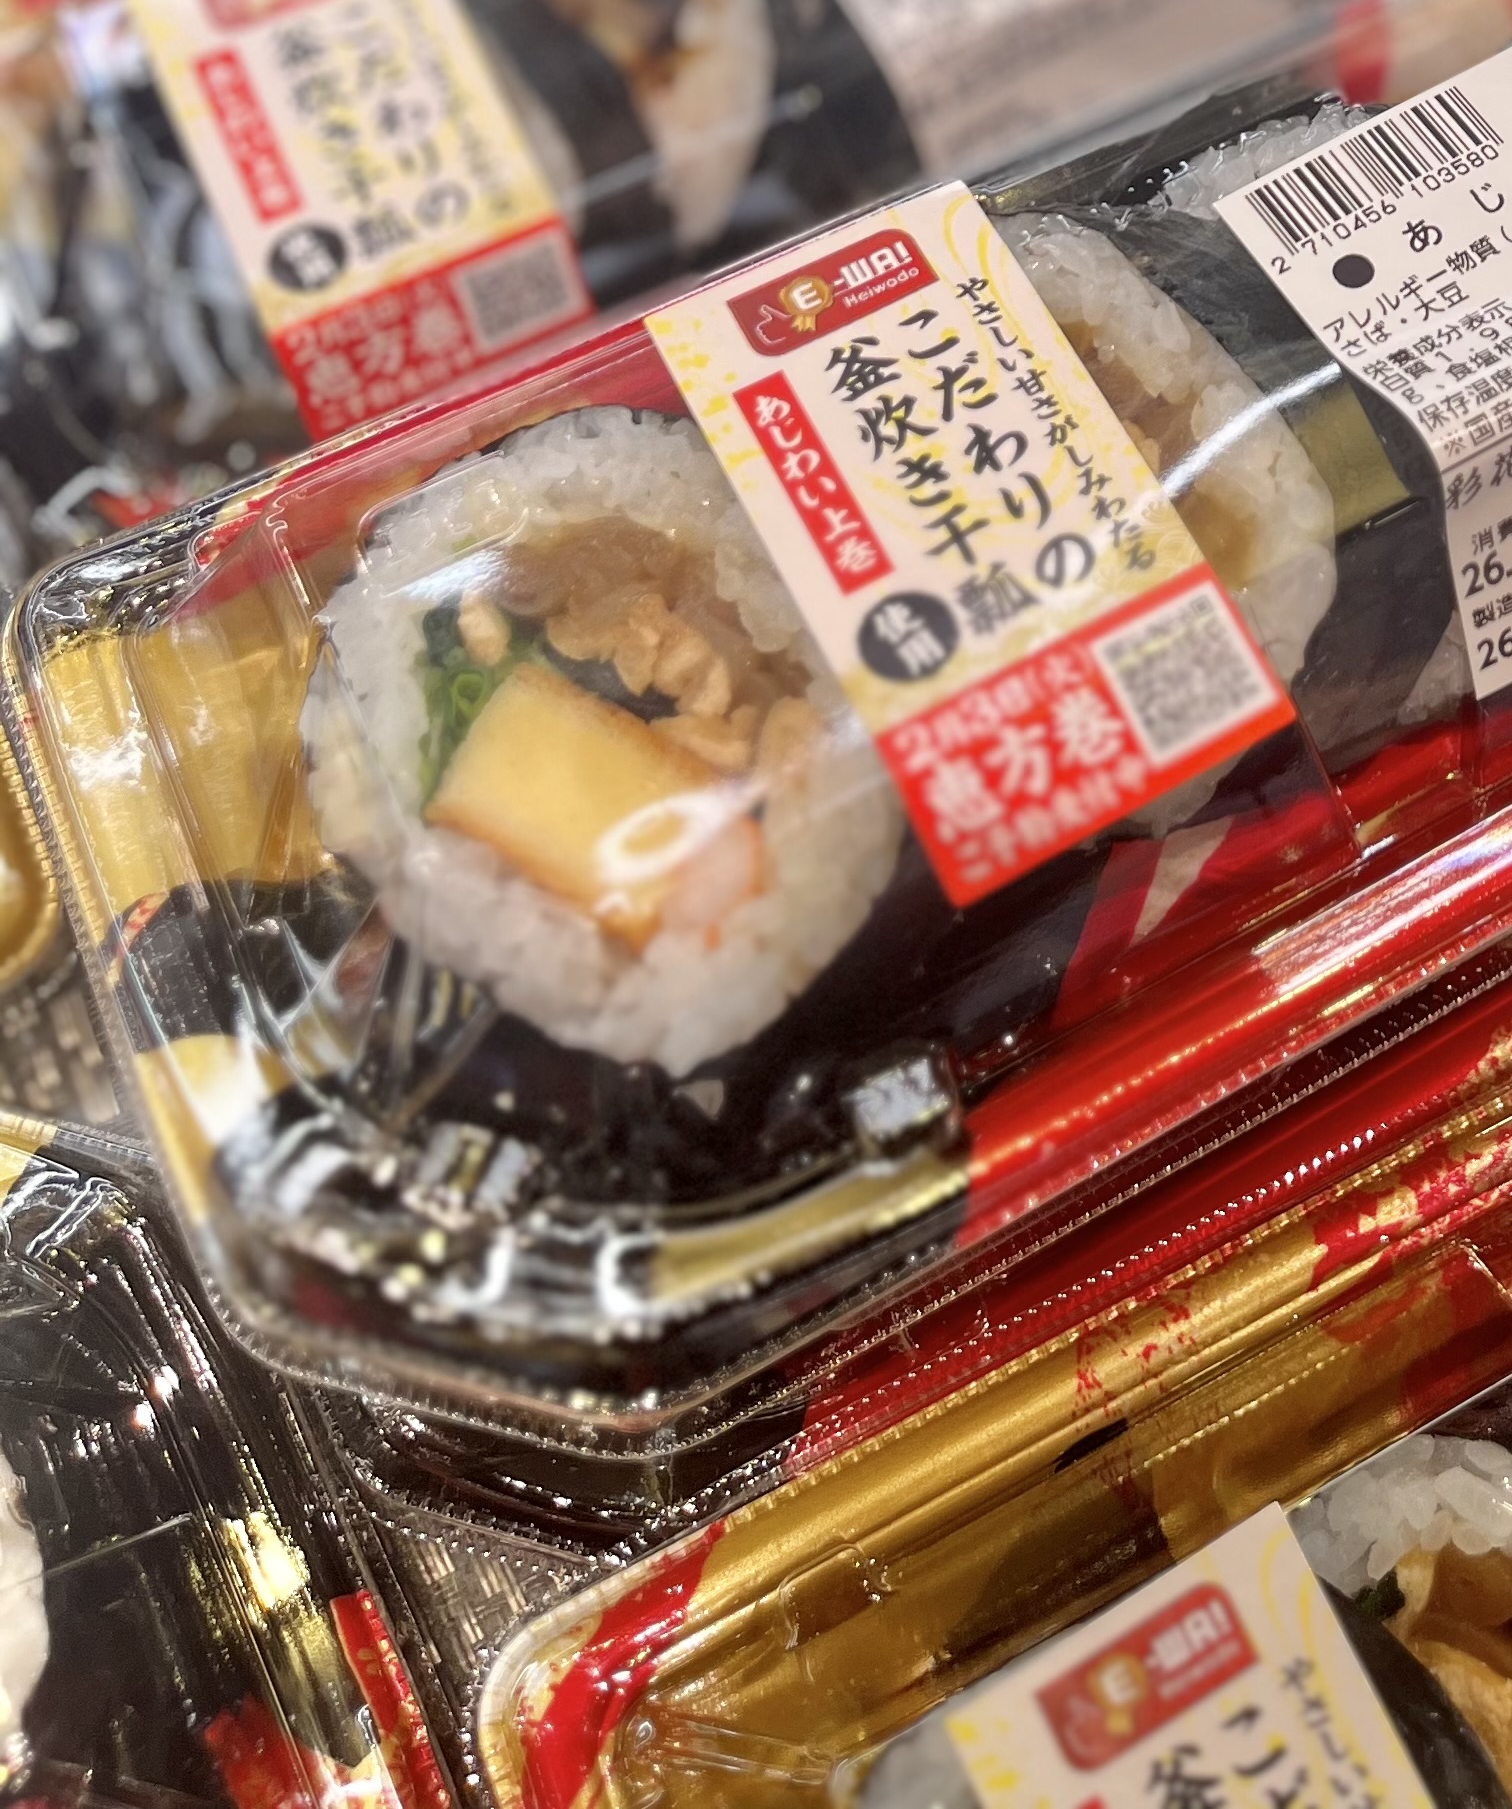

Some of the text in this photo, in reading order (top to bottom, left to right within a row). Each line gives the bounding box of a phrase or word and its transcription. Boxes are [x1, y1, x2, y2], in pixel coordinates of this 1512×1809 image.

[1271, 143, 1501, 276] 2 710456 103580
[754, 394, 880, 574] あじわい上巻
[898, 307, 1096, 589] こだわりの
